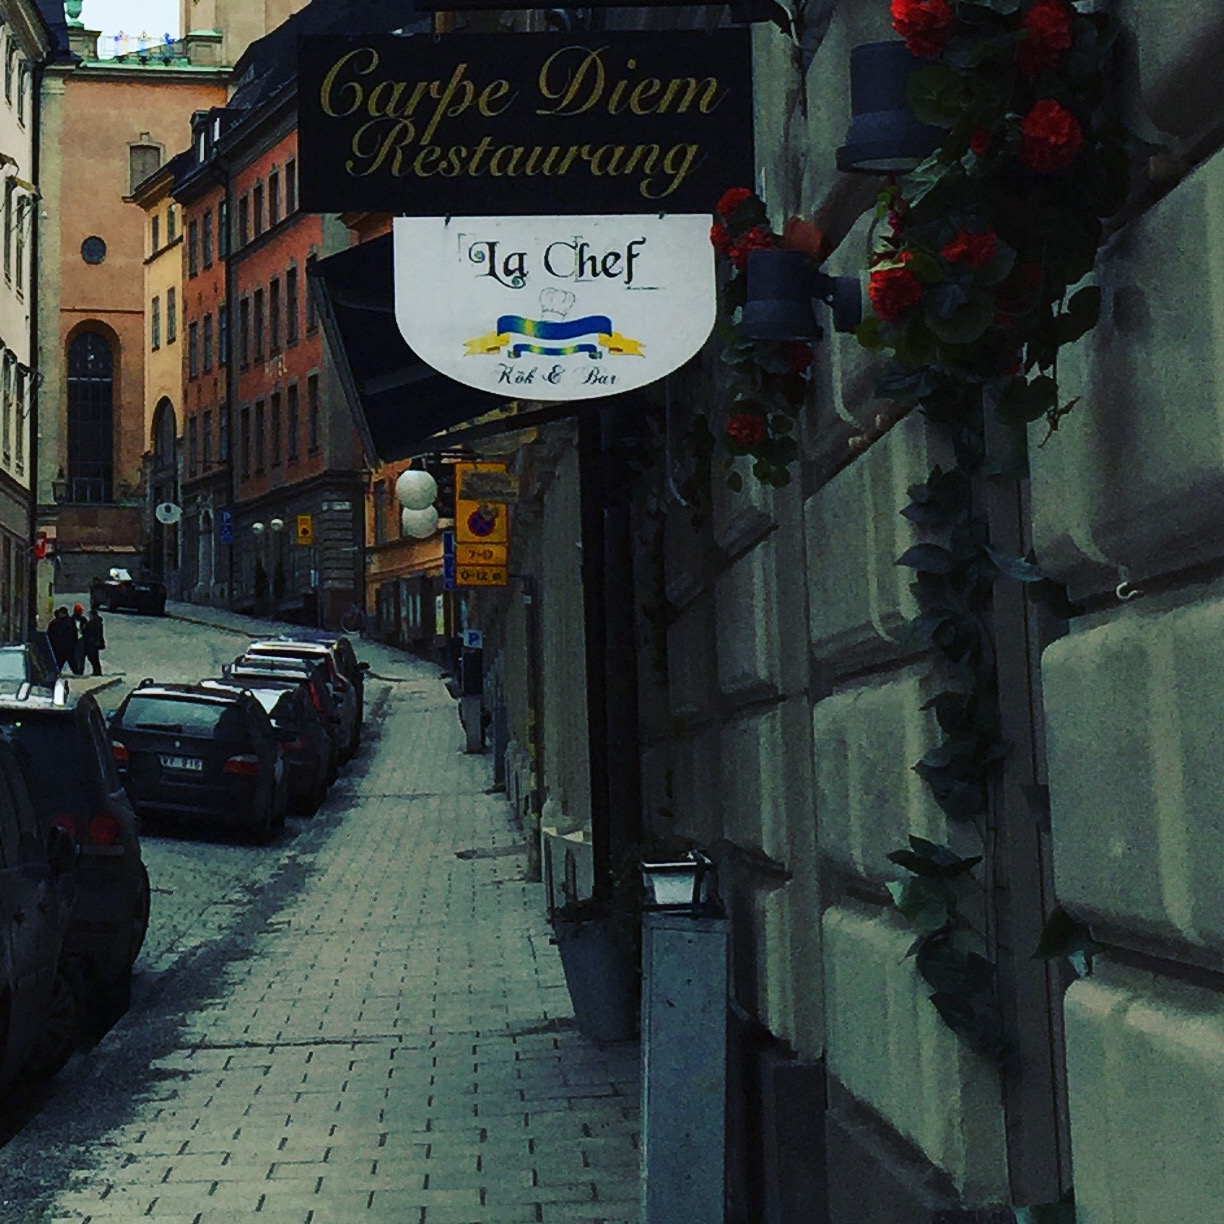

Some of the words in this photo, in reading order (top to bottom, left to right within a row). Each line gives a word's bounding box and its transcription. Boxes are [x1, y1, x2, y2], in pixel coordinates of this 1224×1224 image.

[320, 47, 518, 146] Carpe
[536, 46, 729, 117] Diem
[345, 118, 705, 198] Restaurang
[469, 241, 529, 289] La
[543, 237, 646, 284] Chef
[498, 363, 538, 384] Kök
[542, 364, 566, 384] &
[580, 366, 617, 384] Bar
